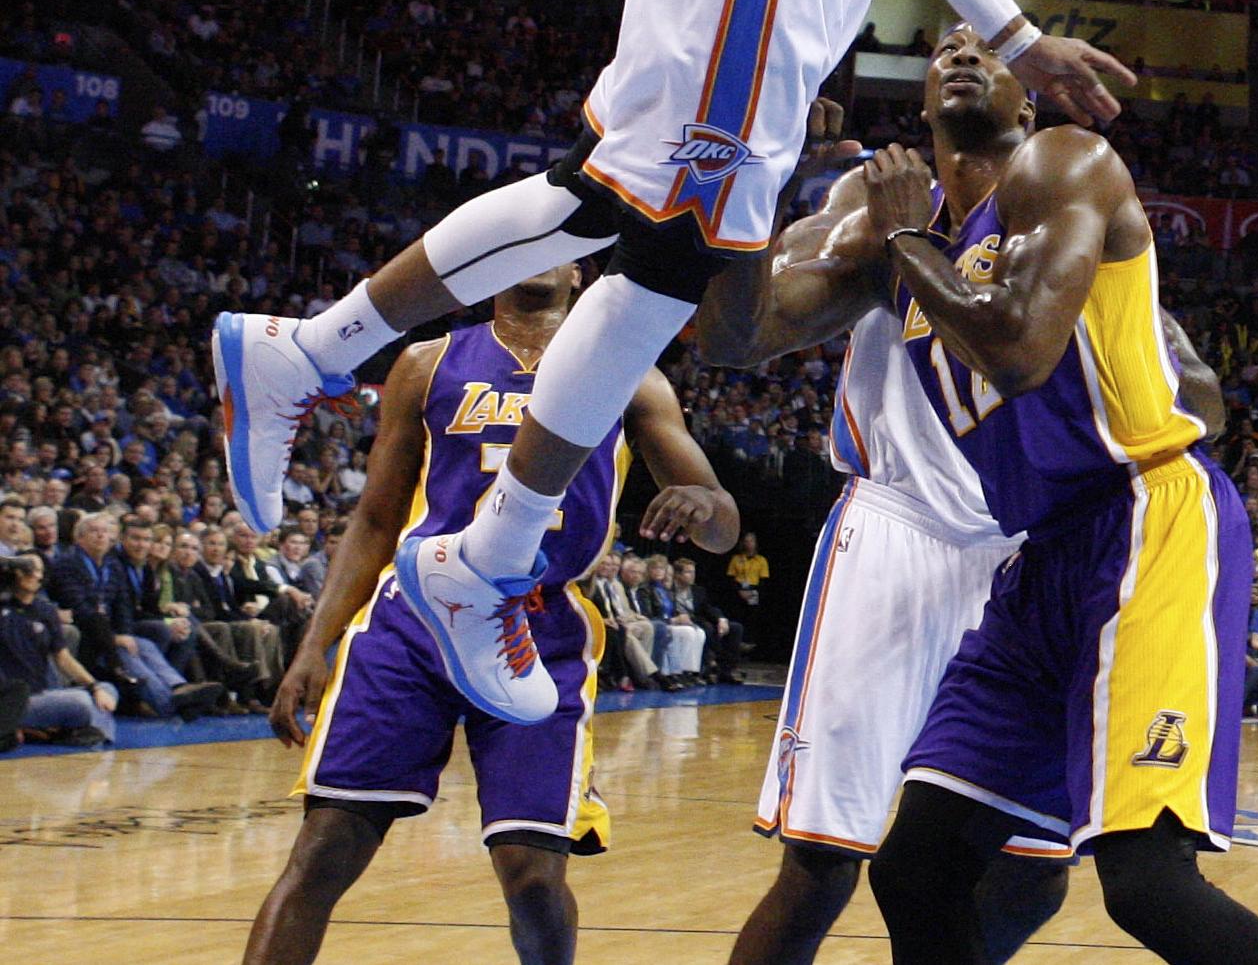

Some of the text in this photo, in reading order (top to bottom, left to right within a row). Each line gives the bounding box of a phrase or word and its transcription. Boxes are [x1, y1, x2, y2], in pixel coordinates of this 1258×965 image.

[75, 74, 119, 100] 108
[207, 96, 250, 119] 109
[669, 140, 736, 160] OKC
